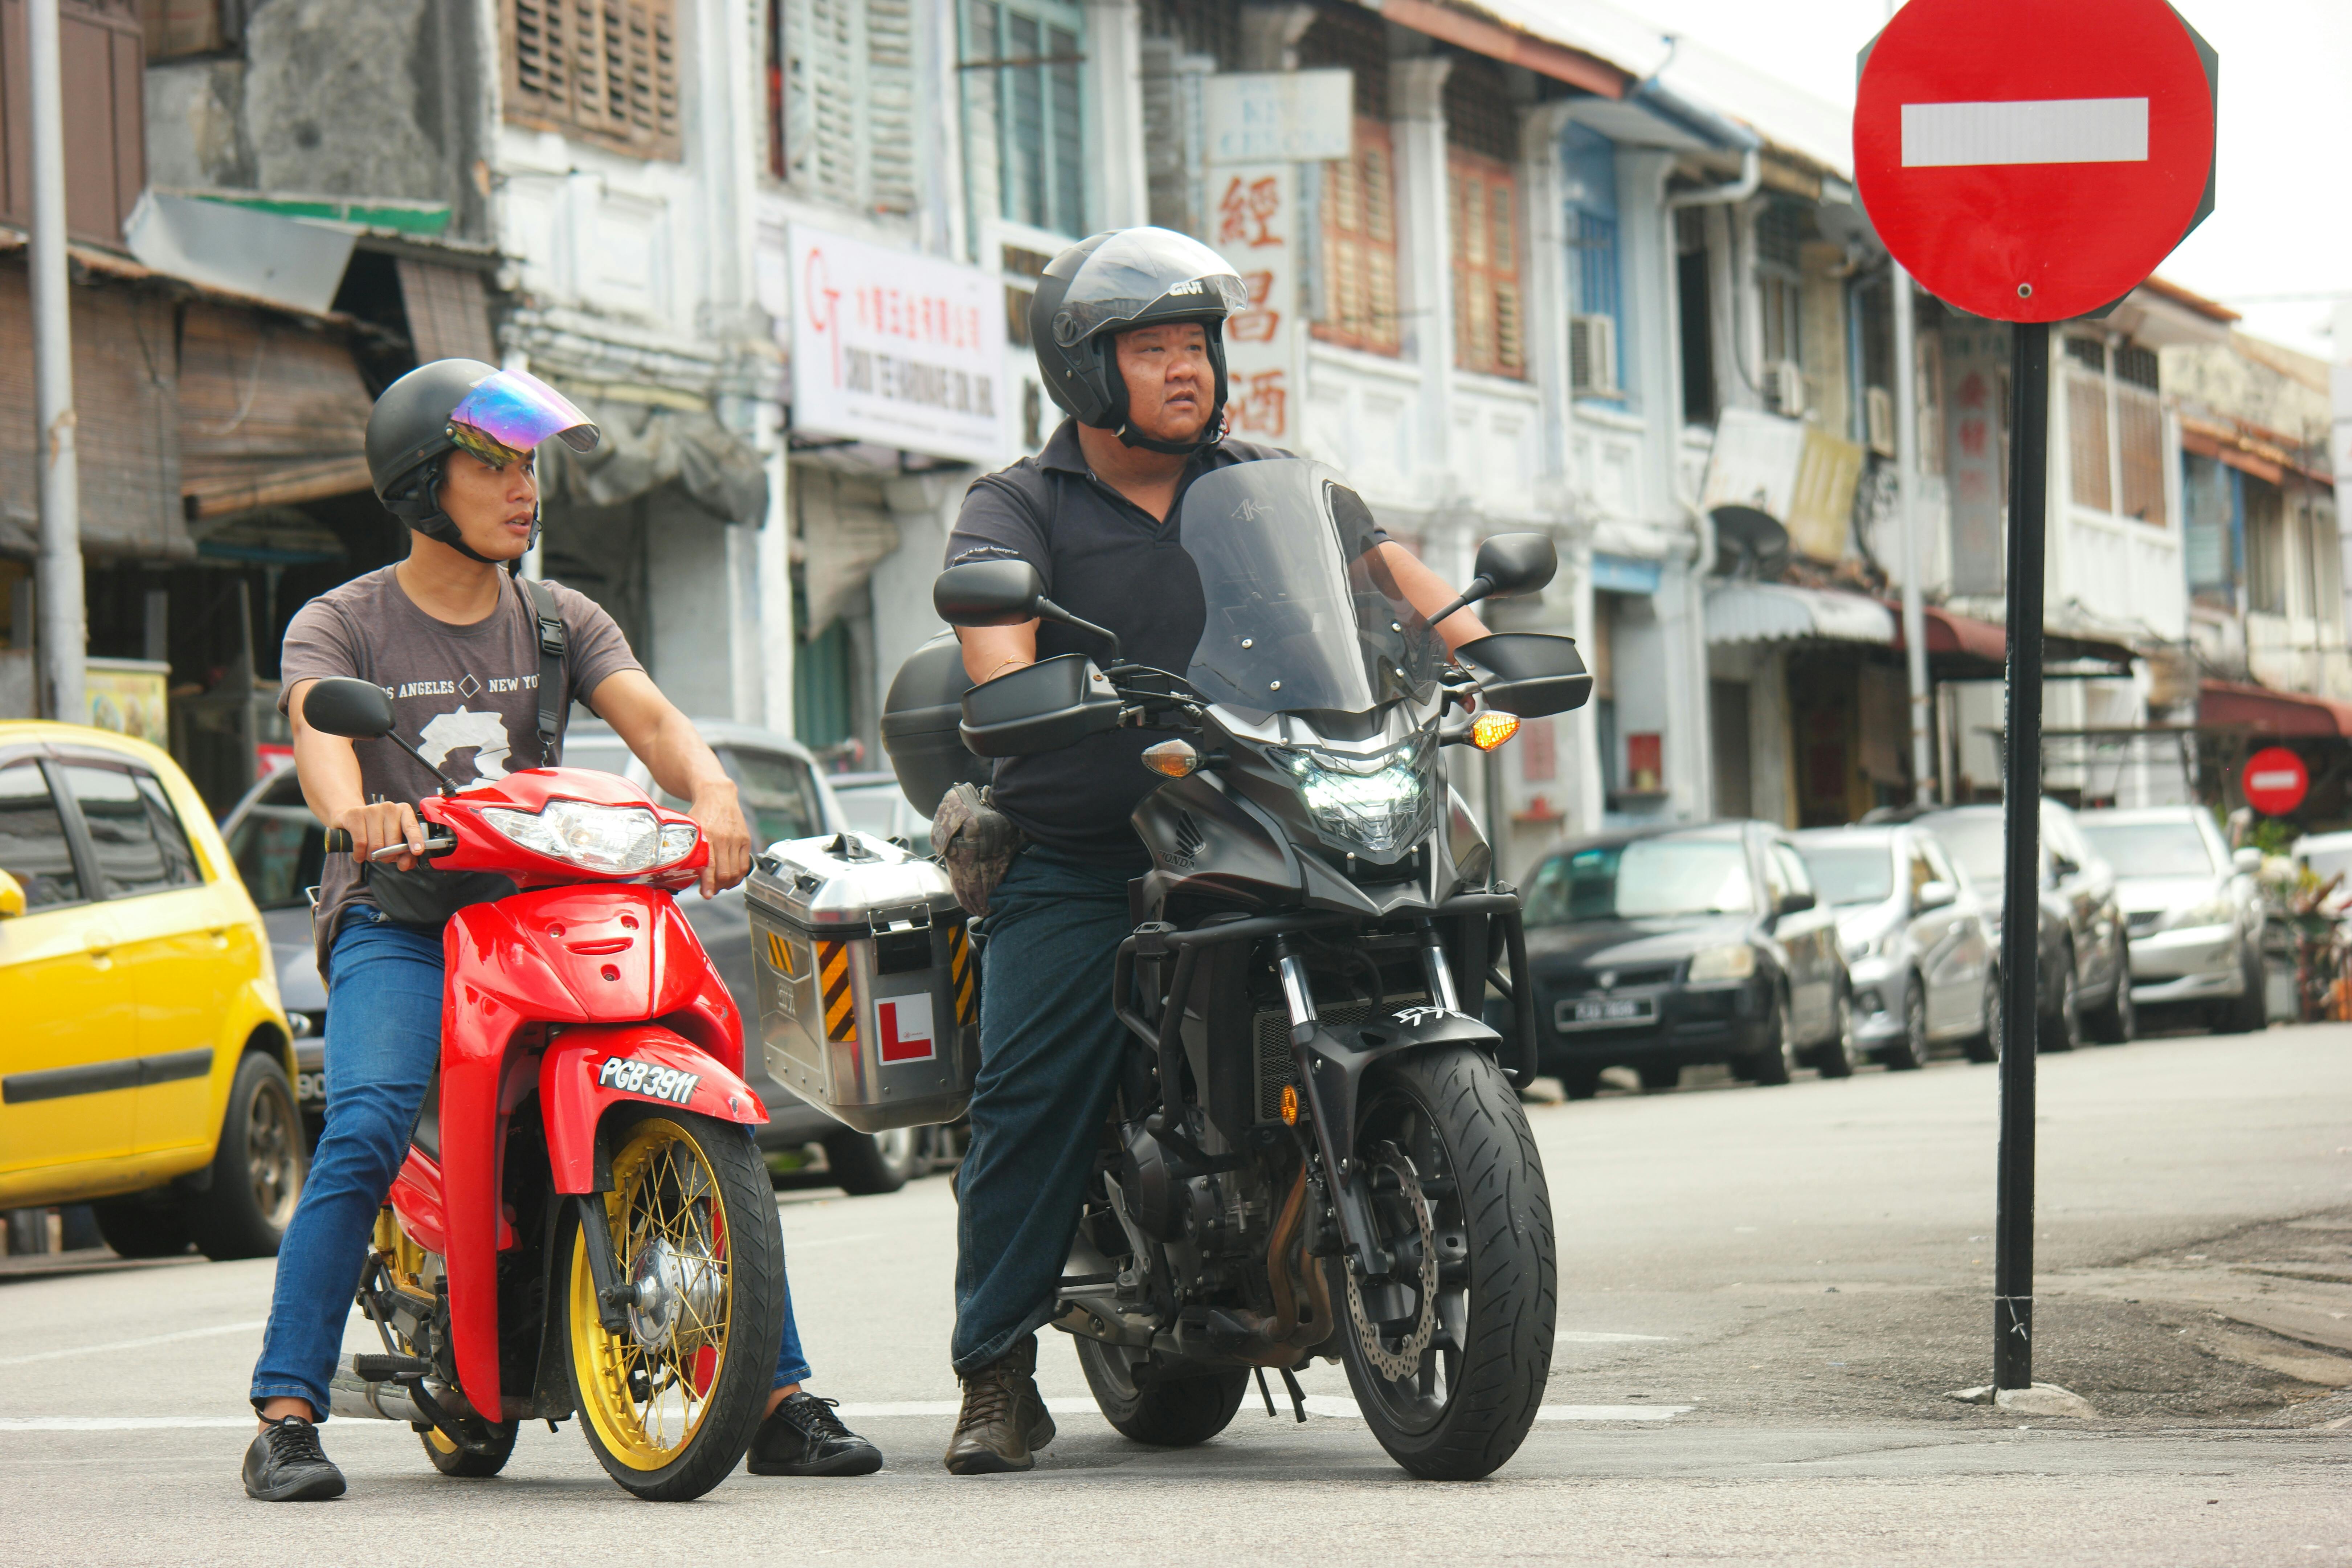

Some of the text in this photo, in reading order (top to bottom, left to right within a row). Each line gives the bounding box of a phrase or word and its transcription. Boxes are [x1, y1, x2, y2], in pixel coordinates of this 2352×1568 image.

[1169, 281, 1204, 297] GIVI
[399, 681, 455, 698] ANGELES
[489, 677, 519, 693] NEW
[522, 673, 540, 690] YO
[878, 1002, 932, 1061] L
